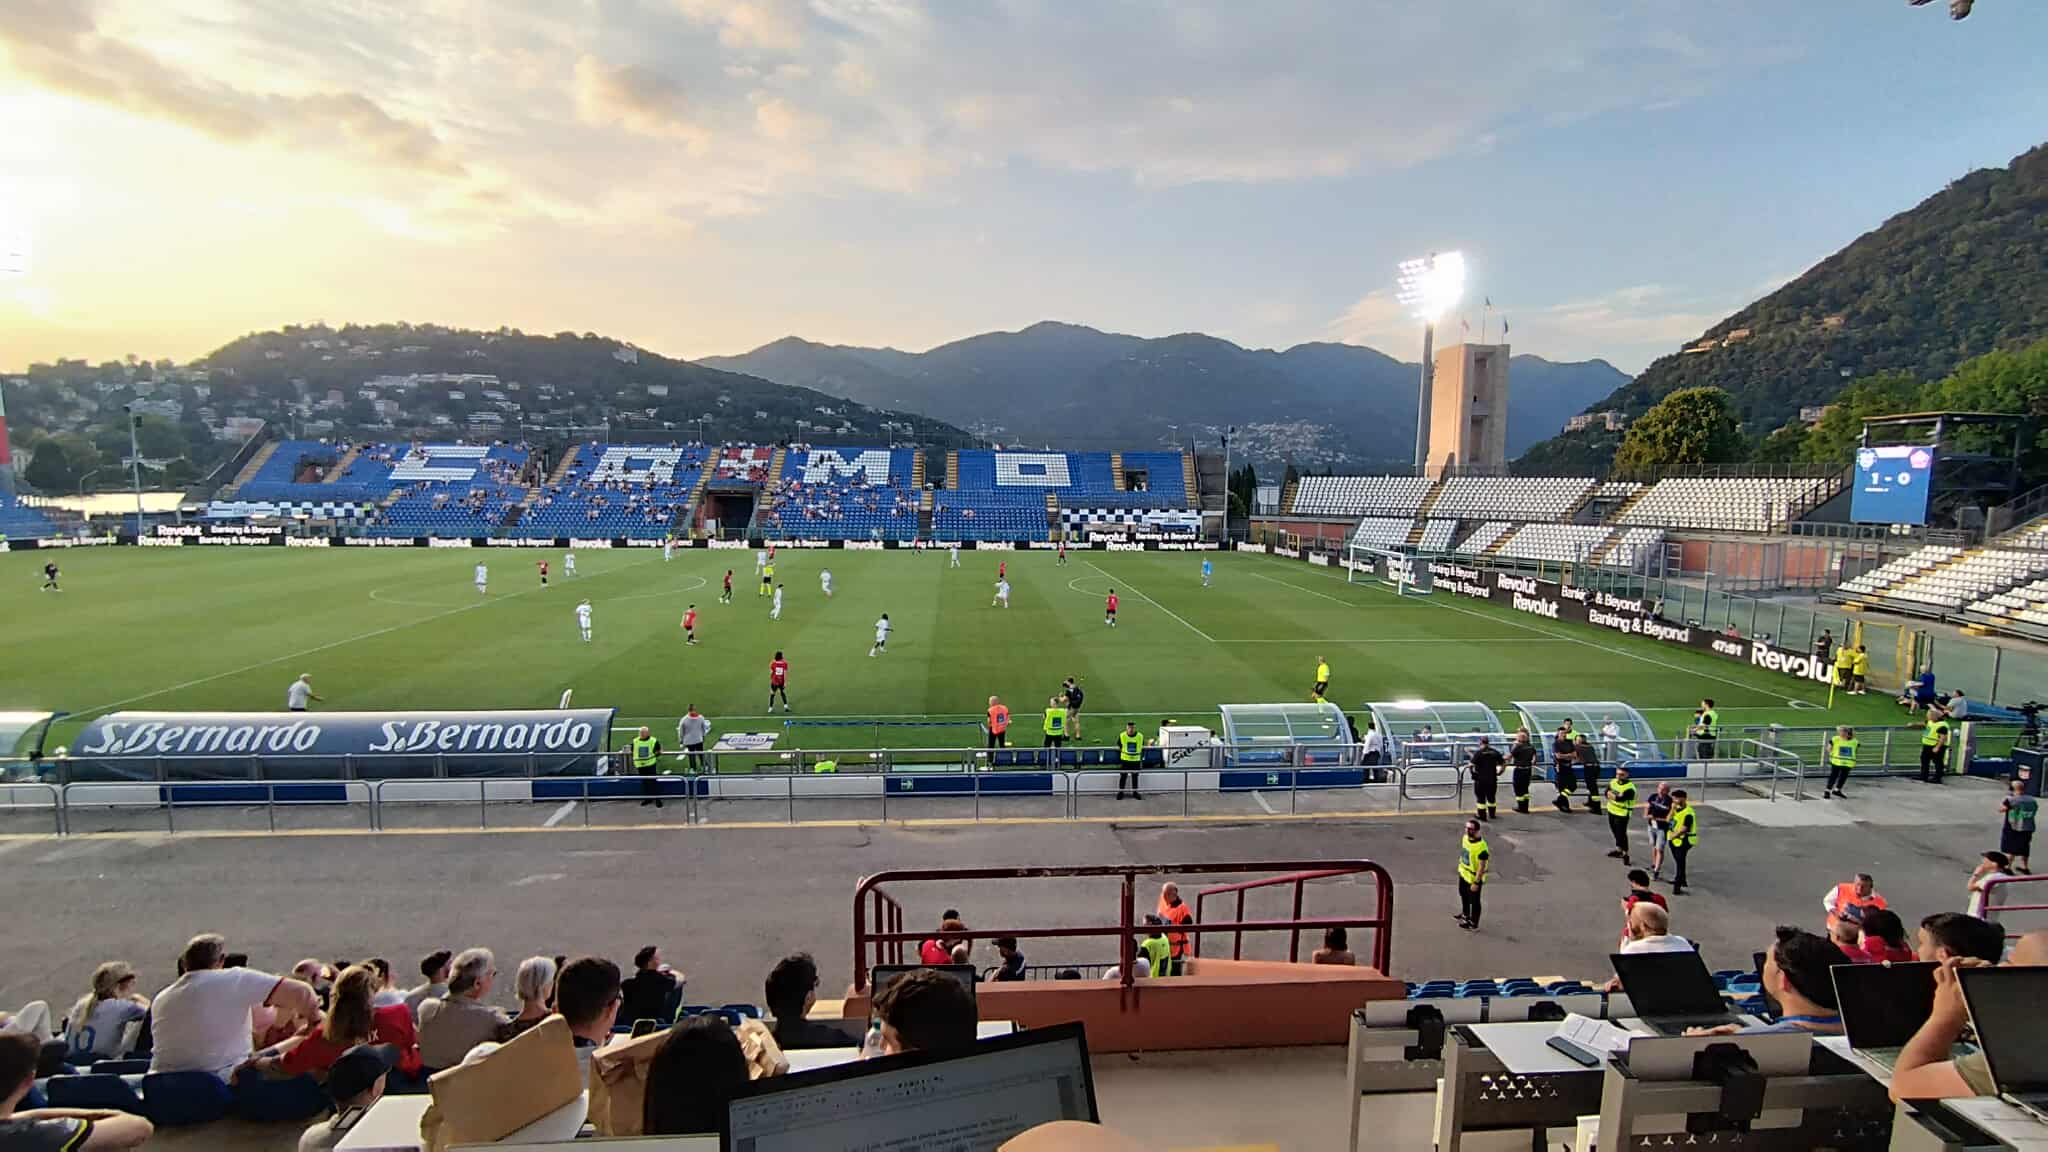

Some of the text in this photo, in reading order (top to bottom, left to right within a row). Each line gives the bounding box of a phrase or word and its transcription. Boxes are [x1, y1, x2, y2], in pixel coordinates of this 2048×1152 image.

[1871, 472, 1879, 485] 1
[1897, 472, 1911, 485] 0
[158, 525, 202, 536] Revolut
[1089, 532, 1127, 542] Revolut
[1106, 541, 1144, 552] Revolut
[1497, 573, 1537, 595] Revolut
[1595, 591, 1603, 605] &
[1605, 593, 1641, 612] Beyond
[1513, 592, 1689, 642] Revolut Banking & Beyond
[1751, 642, 1834, 684] Revolu
[83, 720, 320, 754] S.Bernardo
[369, 717, 593, 752] S.Bernardo
